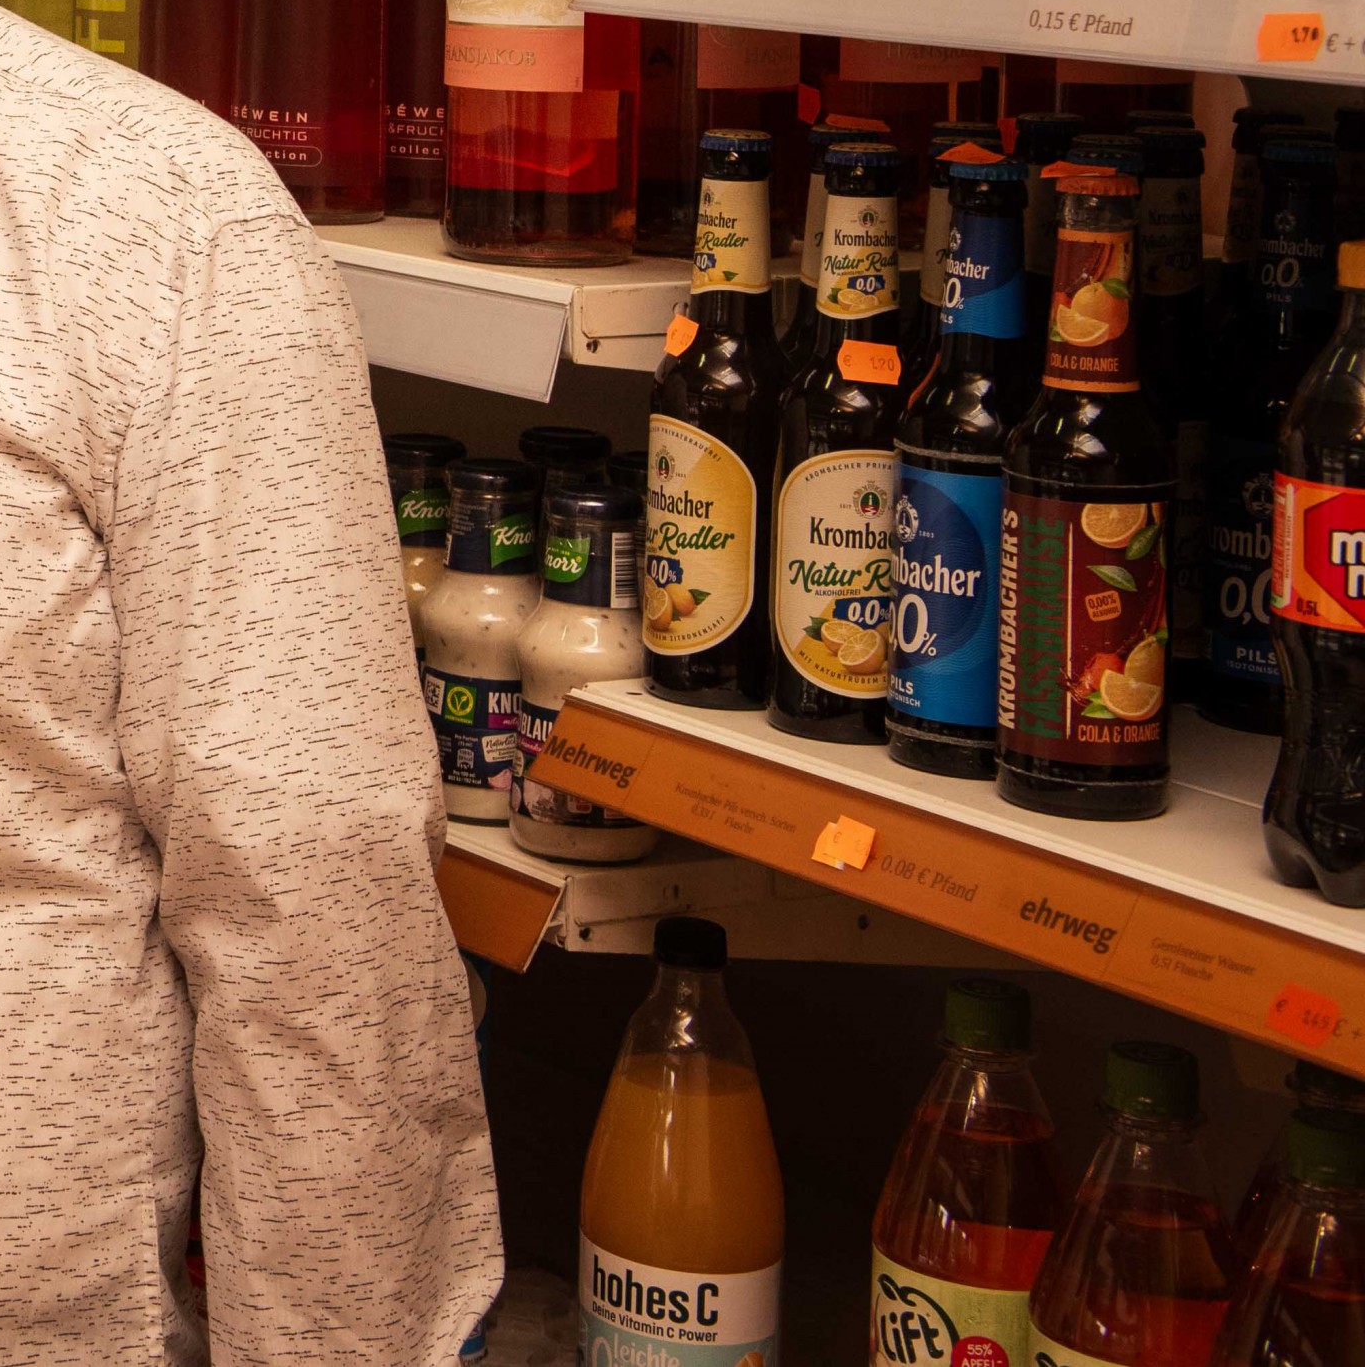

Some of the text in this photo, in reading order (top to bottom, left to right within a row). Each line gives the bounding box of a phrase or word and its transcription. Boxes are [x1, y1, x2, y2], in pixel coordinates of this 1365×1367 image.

[1029, 8, 1134, 38] 0,15 € Pfand
[703, 231, 749, 251] Radler
[824, 254, 865, 276] Natur
[843, 355, 852, 368] €
[1050, 352, 1120, 373] COLA & ORANGE
[804, 462, 862, 483] KROMBACHER
[657, 521, 735, 556] Radler
[650, 558, 678, 584] 0,0%
[788, 559, 862, 593] Natur
[814, 588, 862, 597] ALKOHOLFREI
[669, 614, 727, 642] ZITRONENSAFT
[998, 507, 1020, 730] KROMBACHER'S
[1019, 517, 1066, 739] FASSBRAUSE
[798, 649, 812, 666] MIT
[1077, 723, 1162, 745] COLA & ORANGE
[544, 735, 638, 789] Mehrweg
[917, 869, 927, 885] €
[928, 871, 979, 902] Pfand
[1019, 898, 1118, 954] ehrweg
[593, 1253, 720, 1327] hohes C
[592, 1300, 718, 1343] Deine Vitamin C Power
[966, 1343, 994, 1357] 55%
